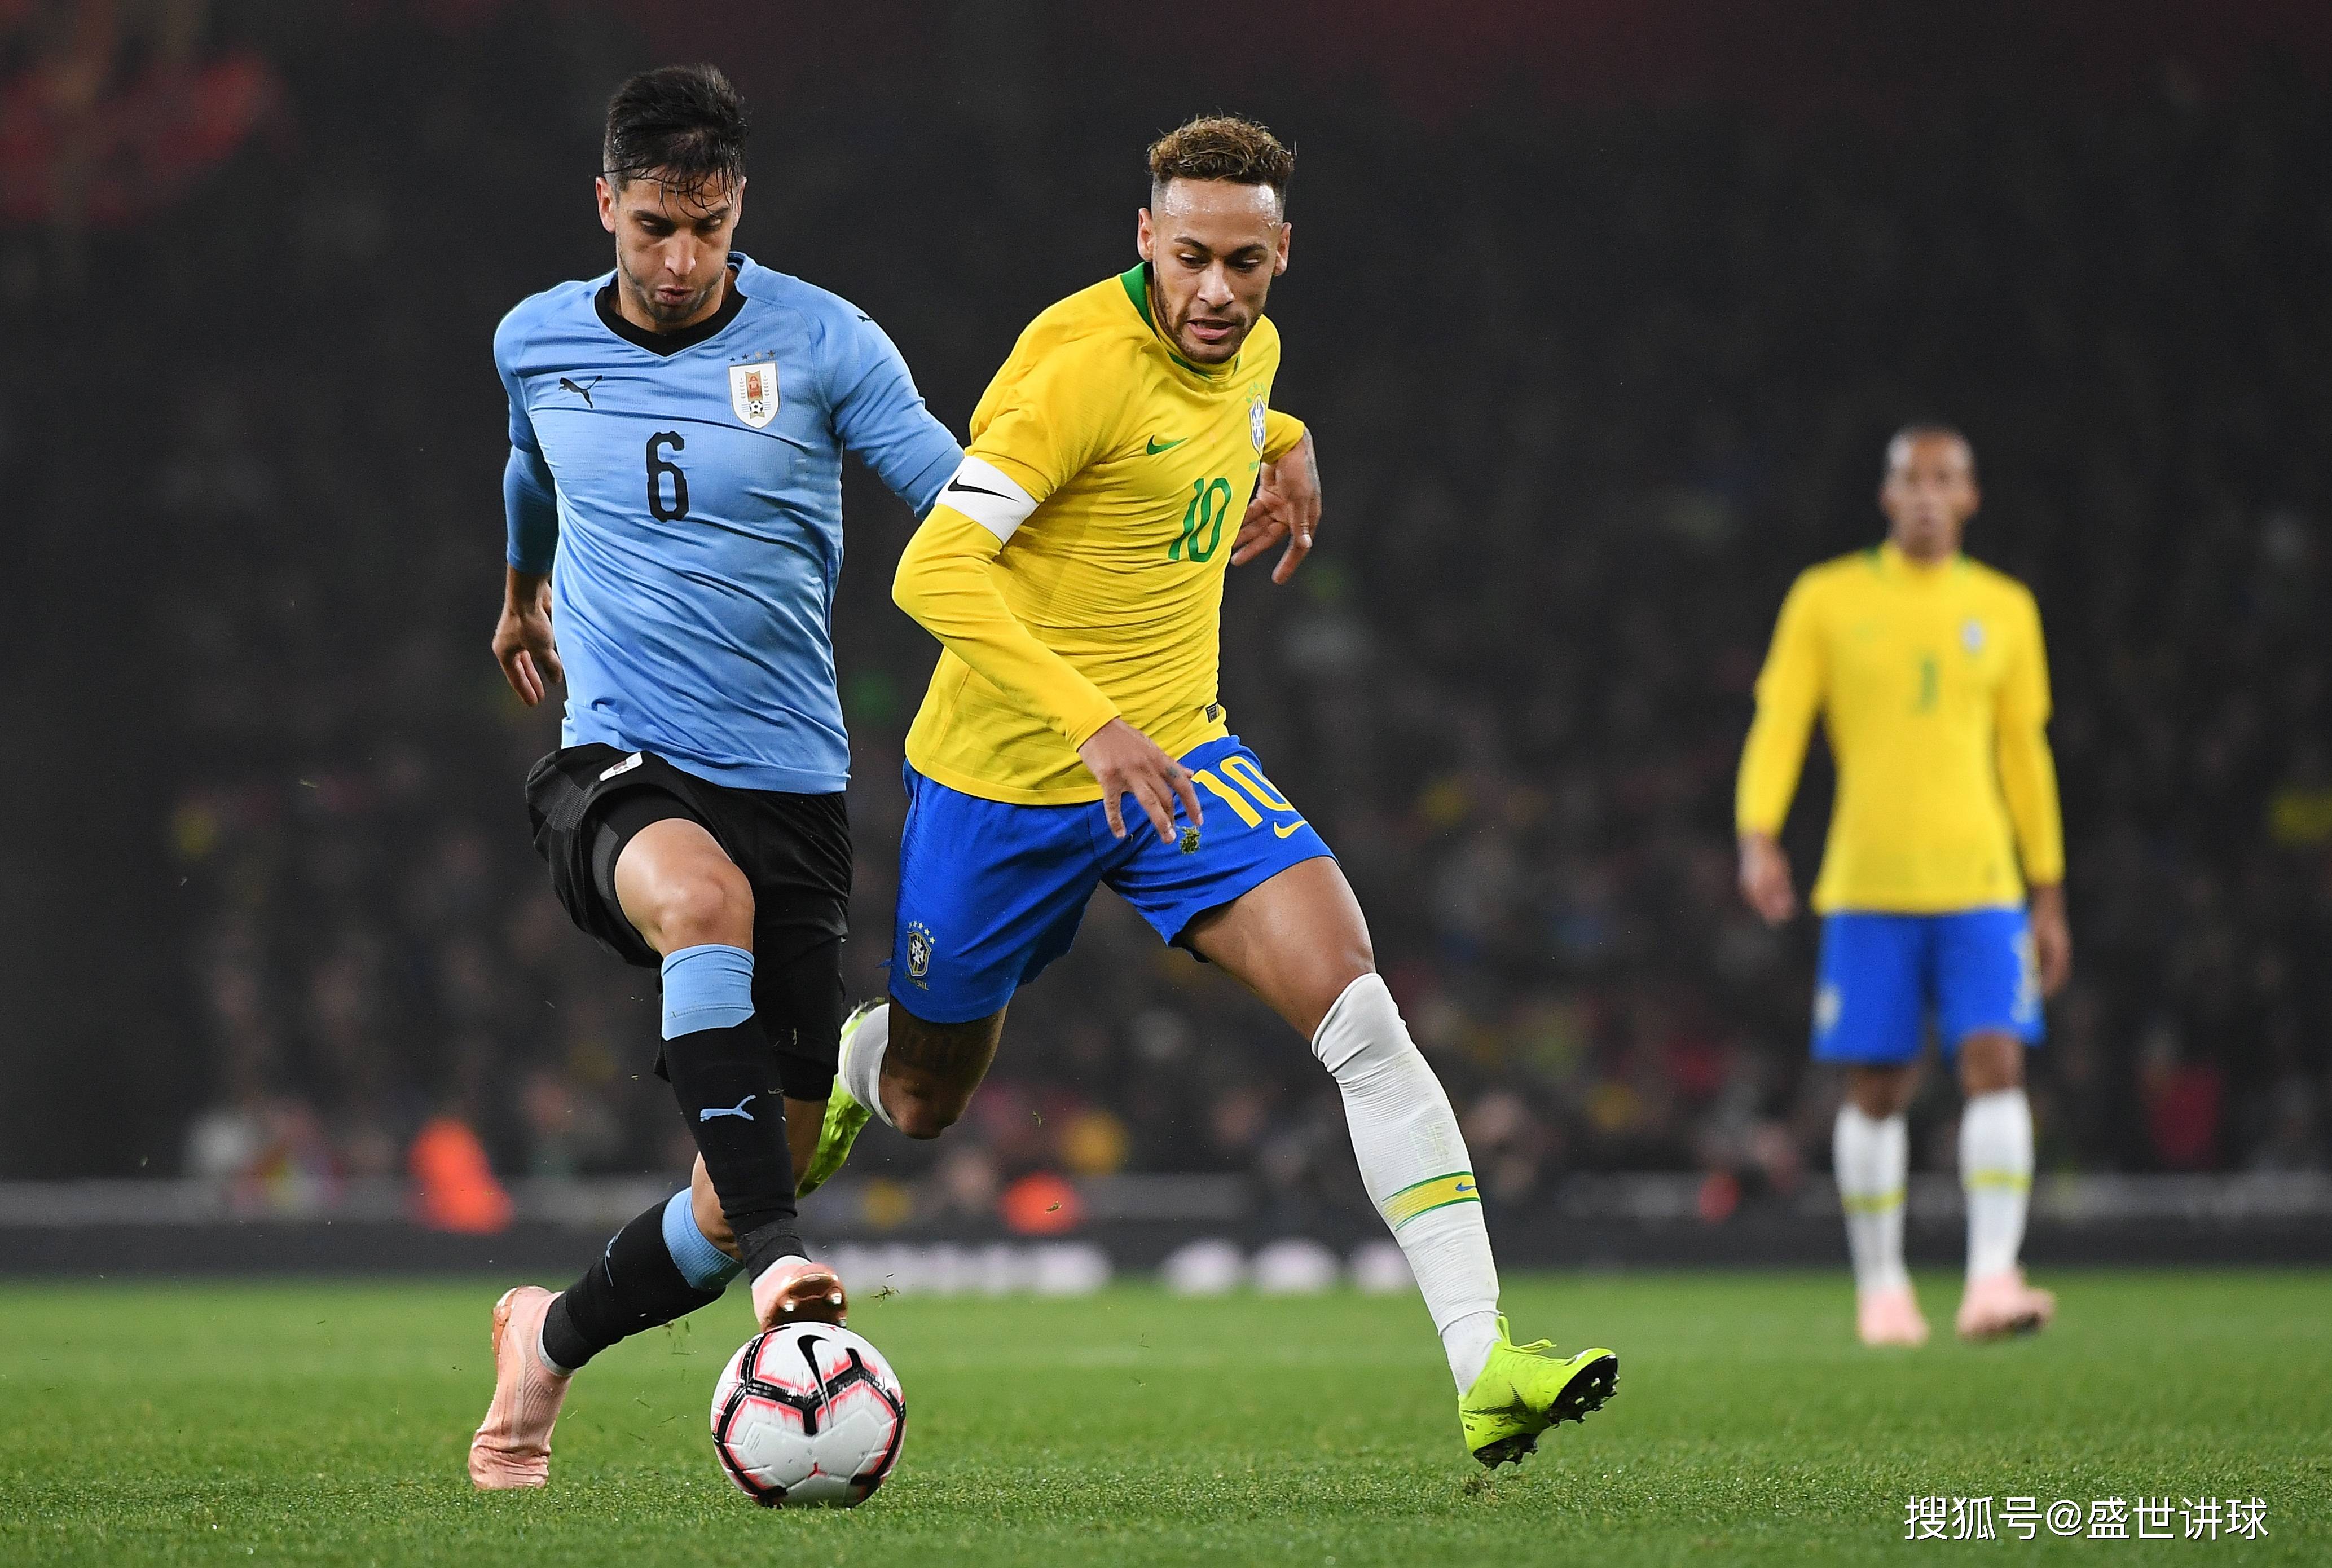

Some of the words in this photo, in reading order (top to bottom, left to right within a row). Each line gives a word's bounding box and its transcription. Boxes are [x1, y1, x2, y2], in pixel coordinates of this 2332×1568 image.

[646, 431, 689, 522] 6
[1168, 478, 1231, 562] 10
[1190, 756, 1295, 829] 10
[905, 971, 929, 990] SIL
